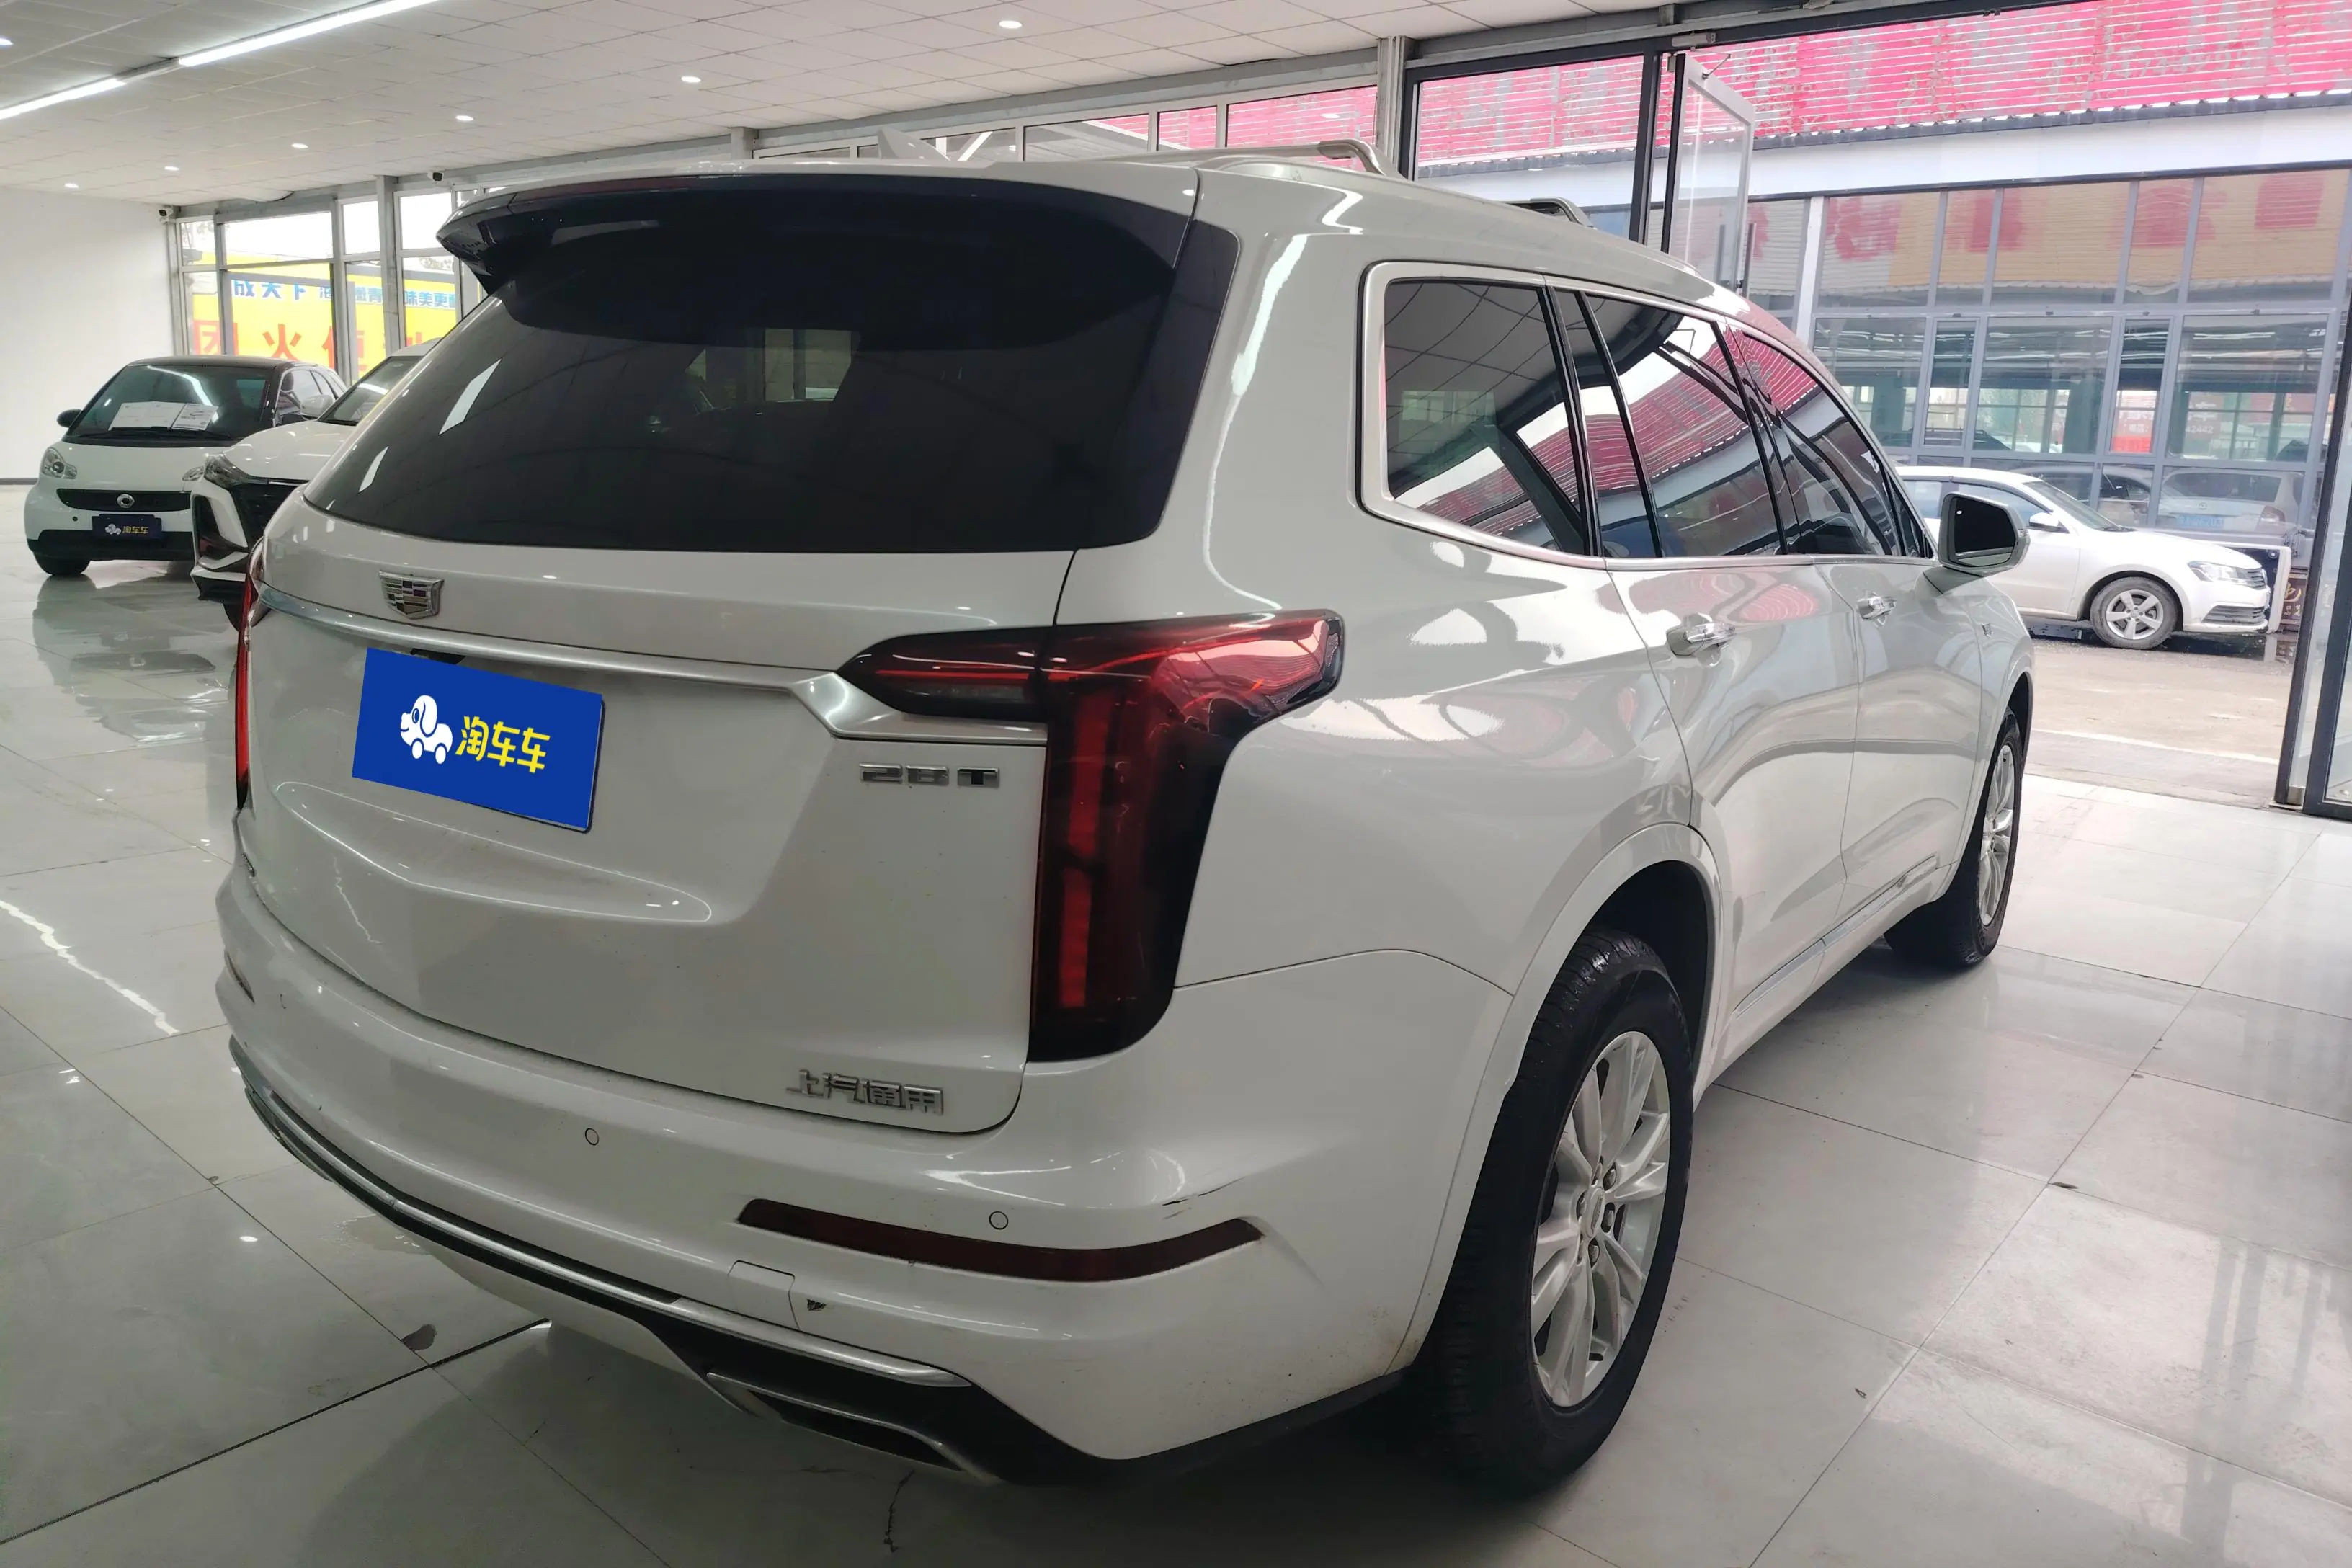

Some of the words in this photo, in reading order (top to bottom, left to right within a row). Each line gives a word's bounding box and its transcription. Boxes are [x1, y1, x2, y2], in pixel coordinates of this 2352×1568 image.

[859, 762, 999, 788] 28T
[787, 1069, 943, 1115] 上汽通用
